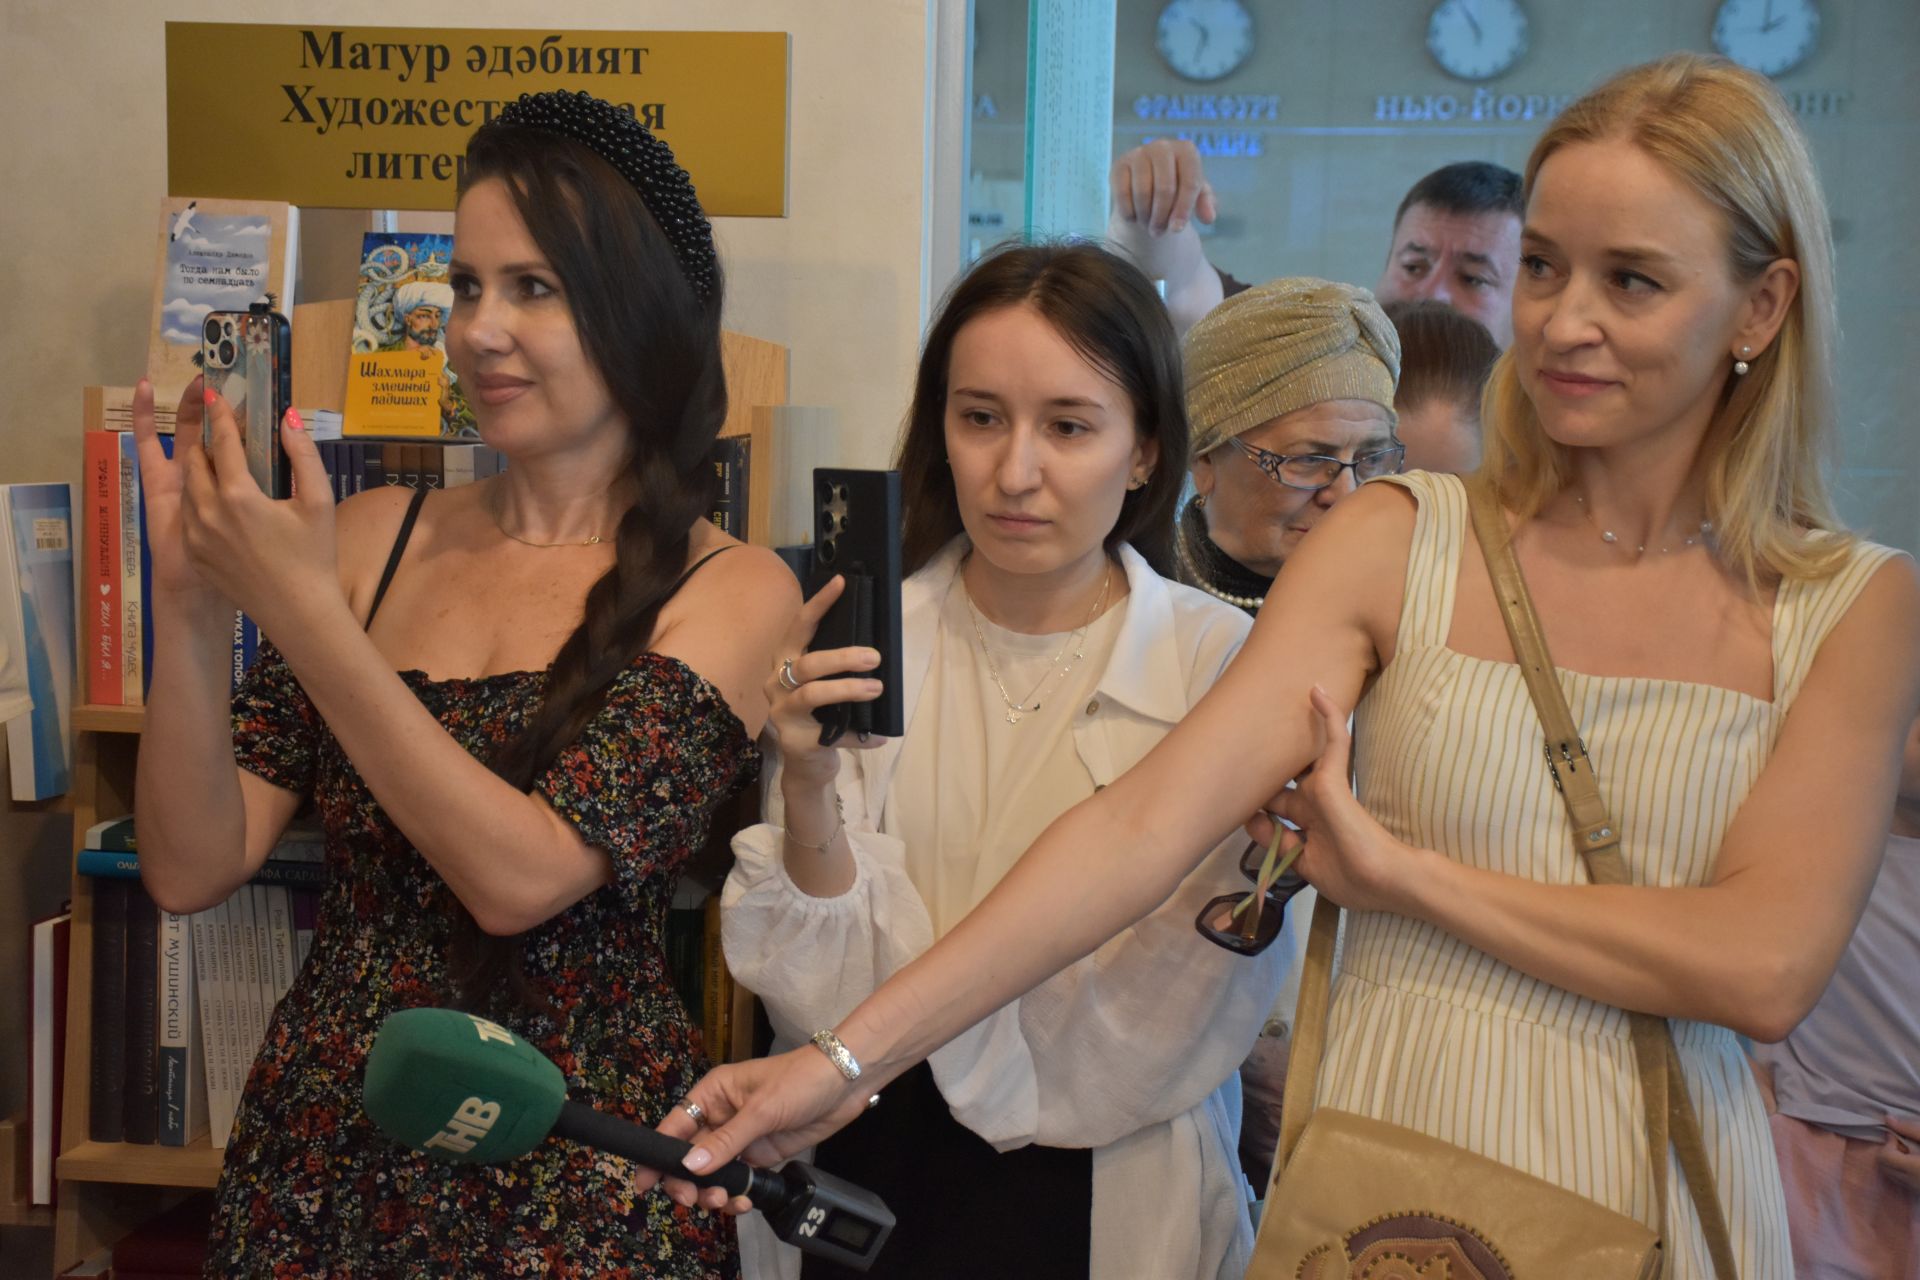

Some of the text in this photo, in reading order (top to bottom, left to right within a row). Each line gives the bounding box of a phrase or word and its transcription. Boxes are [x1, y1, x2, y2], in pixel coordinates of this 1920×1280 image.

[299, 31, 649, 83] Матур әдәбият
[180, 263, 260, 277] Тогда нам было
[183, 277, 194, 285] по
[360, 361, 426, 380] Шахмара
[371, 393, 428, 406] падишах
[372, 381, 431, 393] змеиный
[127, 600, 138, 677] Книга чудес
[165, 938, 181, 1039] мушинский
[423, 1096, 502, 1154] ТНВ
[798, 1206, 826, 1237] 23
